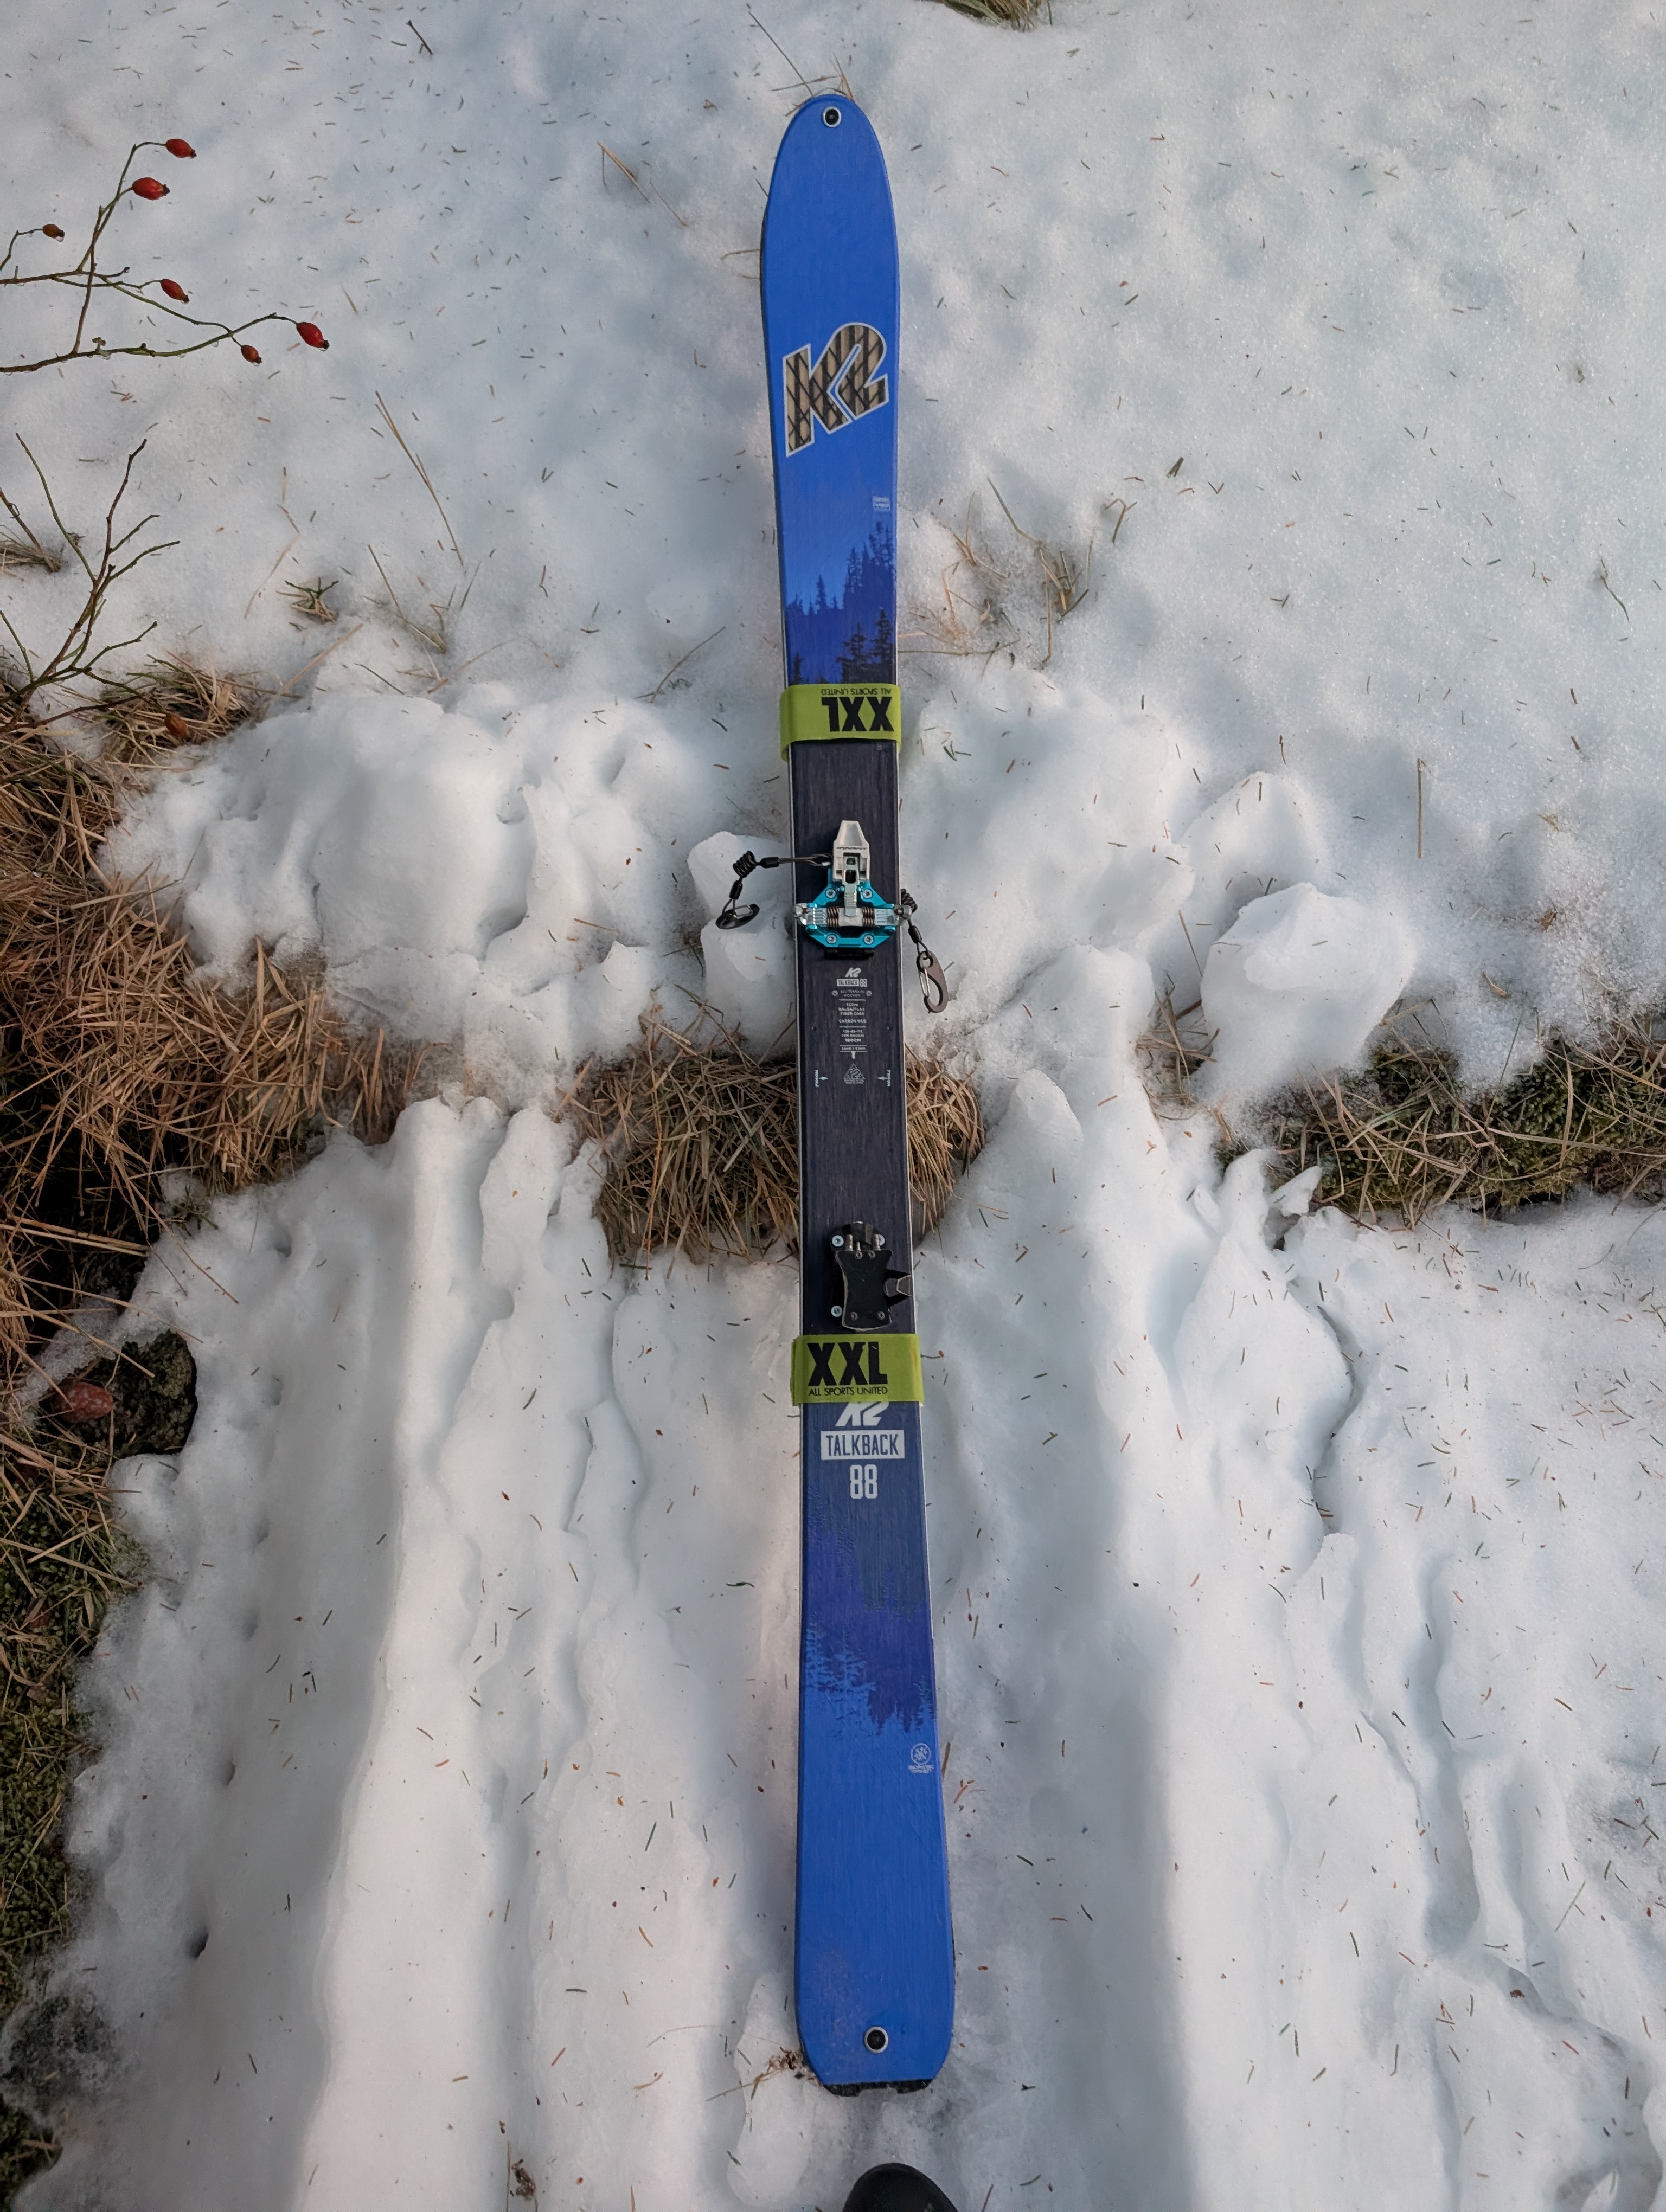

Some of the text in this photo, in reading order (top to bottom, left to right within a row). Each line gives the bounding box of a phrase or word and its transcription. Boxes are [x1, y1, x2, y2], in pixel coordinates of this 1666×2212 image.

[783, 322, 889, 457] K2
[821, 696, 894, 732] XXL
[844, 967, 862, 978] K2
[860, 978, 868, 987] 88
[807, 1341, 888, 1386] XXL
[809, 1386, 888, 1396] ALL SPORTS UNITED
[835, 1401, 889, 1427] K2
[825, 1433, 899, 1457] TALKBACK
[849, 1464, 878, 1500] 88
